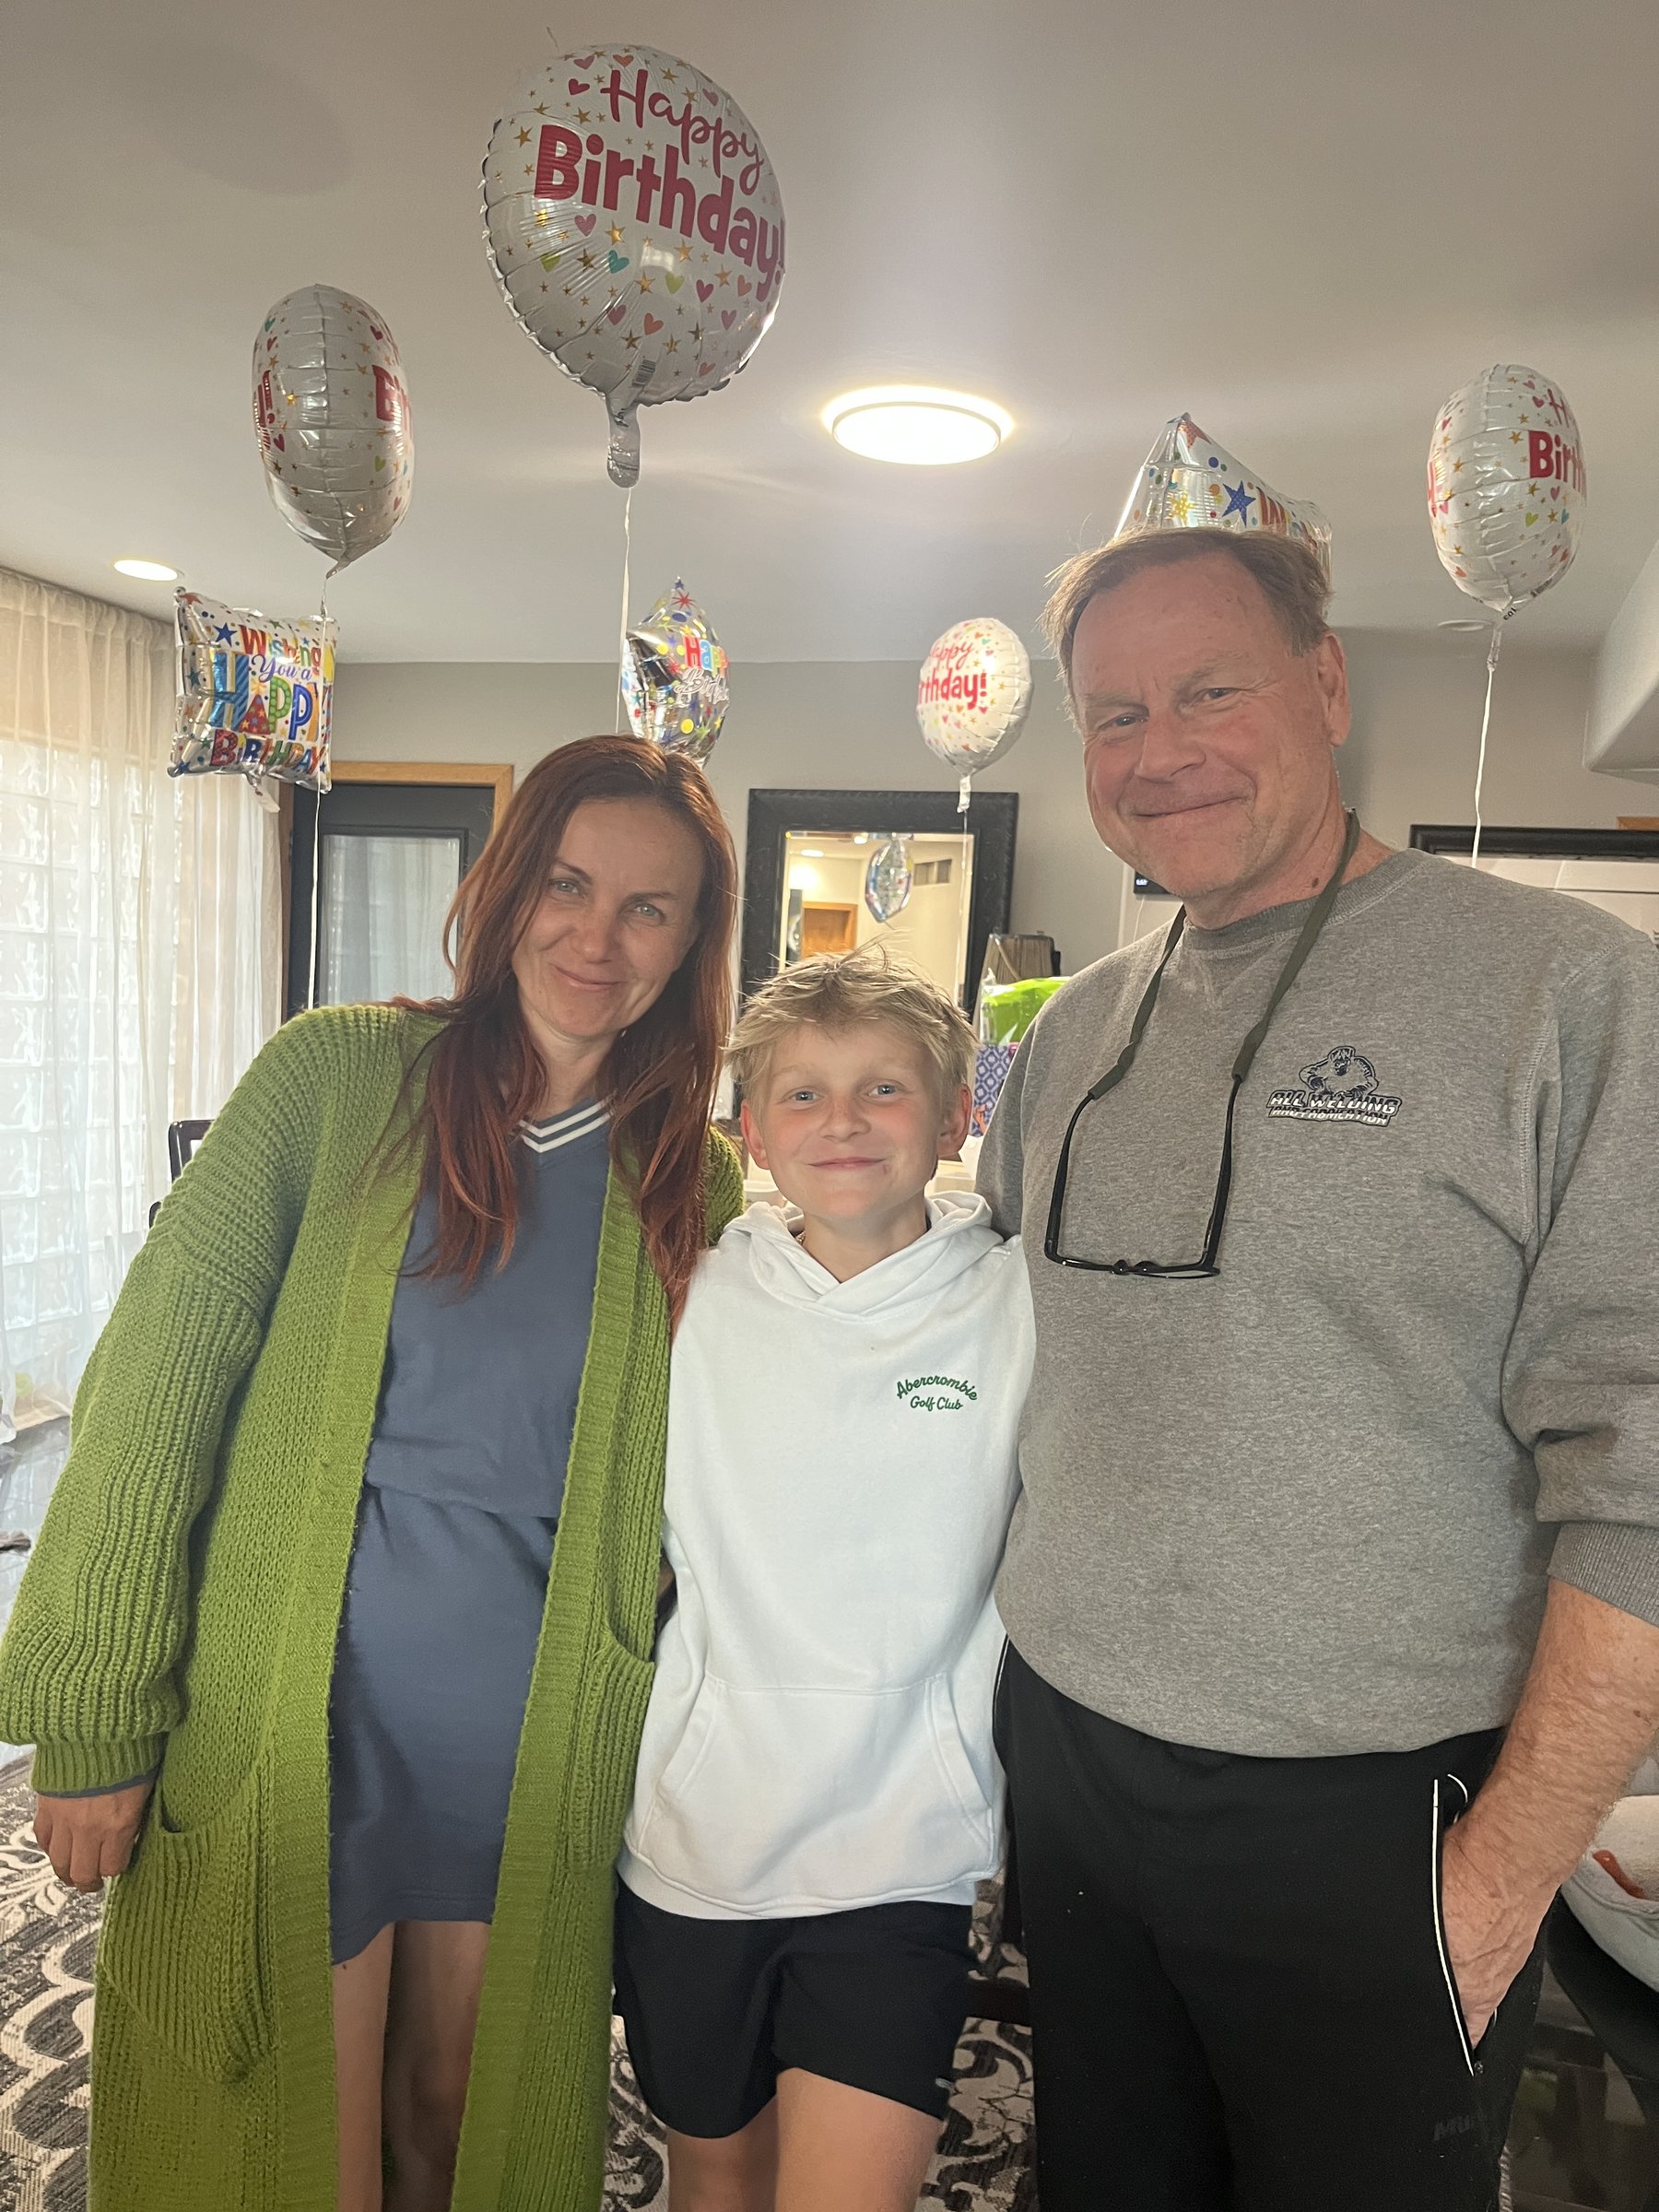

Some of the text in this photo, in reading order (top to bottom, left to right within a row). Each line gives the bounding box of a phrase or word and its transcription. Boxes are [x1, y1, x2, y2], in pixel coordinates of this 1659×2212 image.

[600, 69, 765, 195] Happy
[534, 124, 784, 301] Birthday!
[238, 624, 322, 676] Wishing
[252, 653, 313, 683] You a
[897, 1375, 977, 1400] Abercrombie
[910, 1394, 963, 1412] Golf Club
